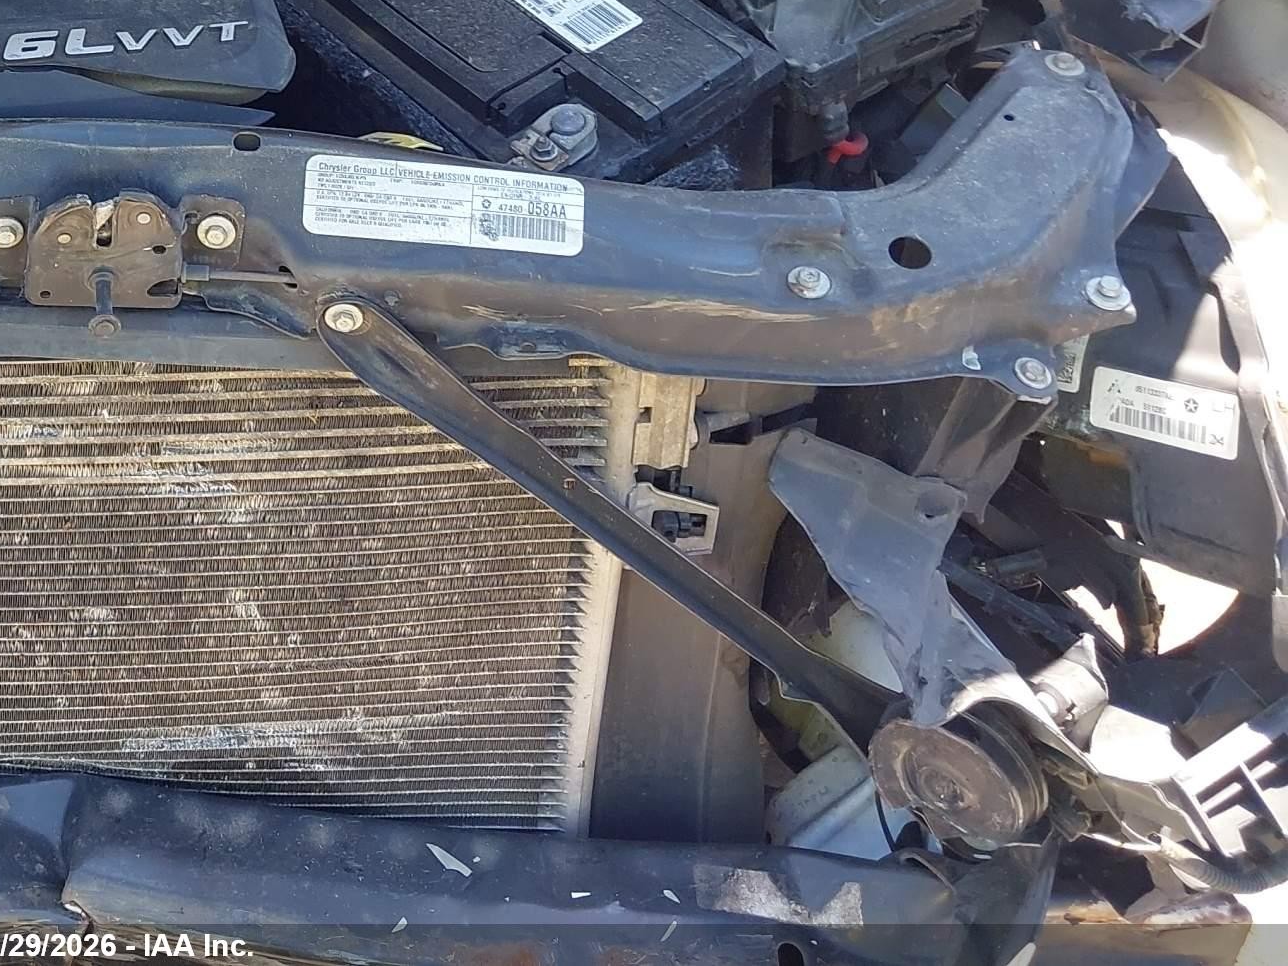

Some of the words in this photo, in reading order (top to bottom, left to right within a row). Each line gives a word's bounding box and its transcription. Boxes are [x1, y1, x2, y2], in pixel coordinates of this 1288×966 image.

[116, 20, 248, 51] VVT
[319, 162, 352, 173] Chrysler
[354, 165, 377, 175] Group
[380, 167, 395, 175] LLC
[398, 169, 430, 179] VEHICLE
[433, 172, 470, 182] EMISSION
[474, 175, 508, 186] CONTROL
[513, 179, 568, 191] INFORMATION
[528, 202, 566, 219] 058AA
